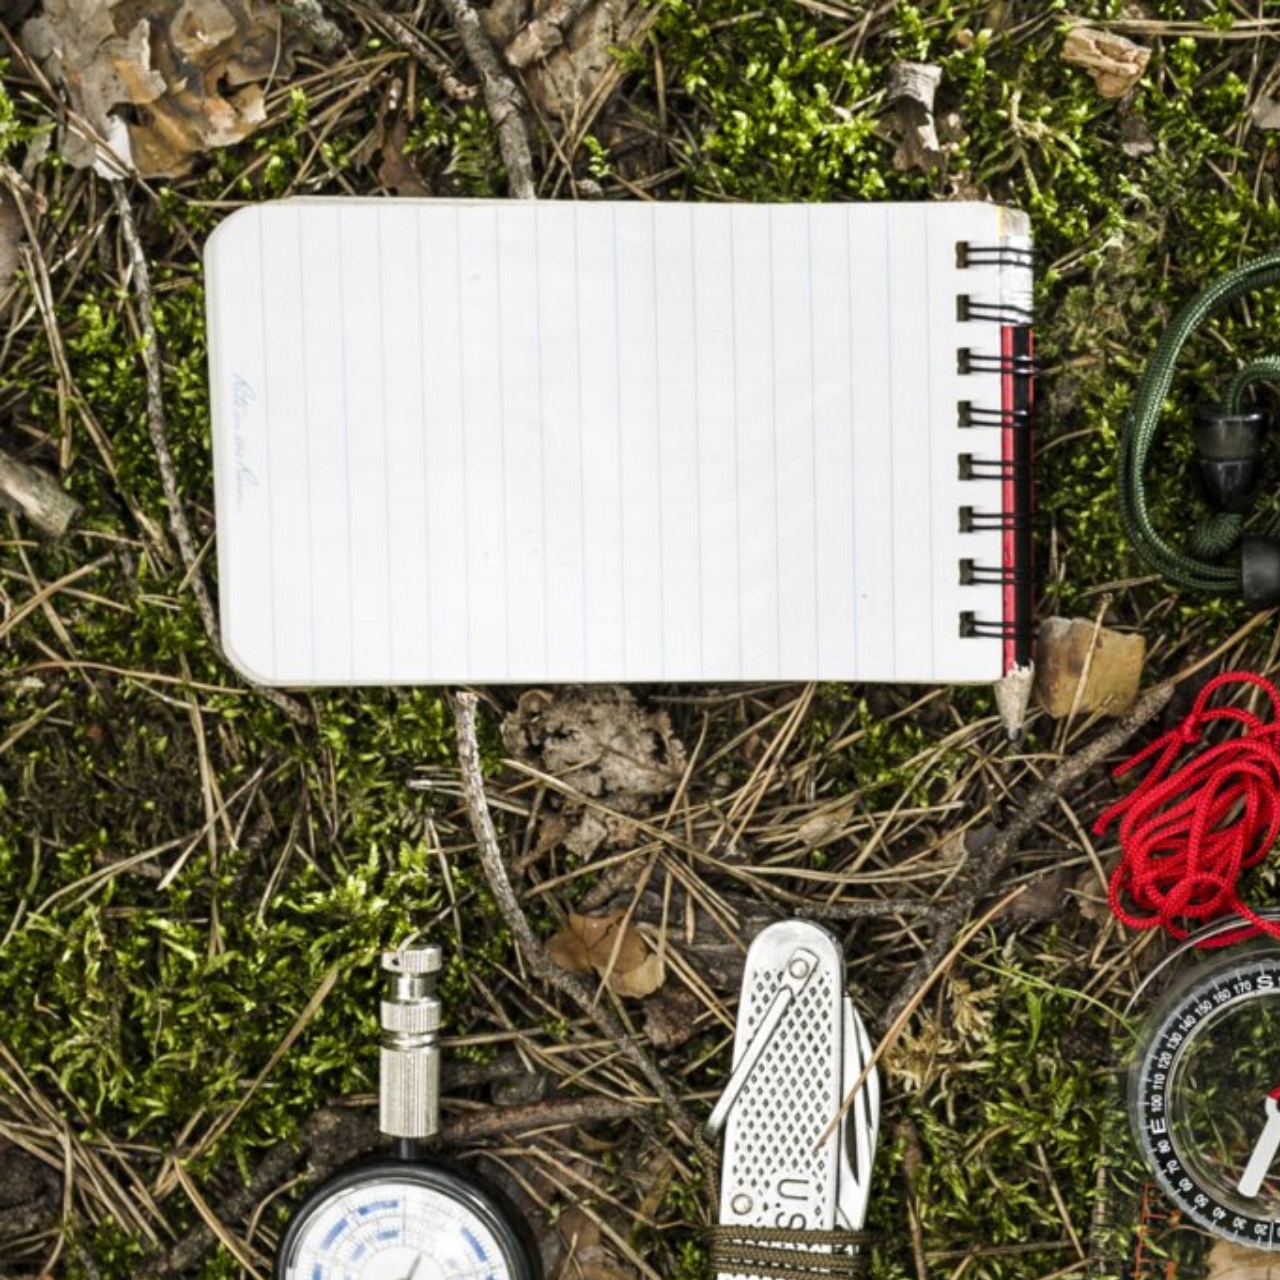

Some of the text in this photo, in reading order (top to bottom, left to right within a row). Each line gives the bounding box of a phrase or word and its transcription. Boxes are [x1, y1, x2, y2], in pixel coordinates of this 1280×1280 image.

[1234, 980, 1251, 995] 170
[1257, 975, 1274, 991] S
[1195, 1000, 1212, 1016] 150
[1179, 1015, 1196, 1031] 140
[1167, 1032, 1182, 1049] 130
[1158, 1052, 1172, 1069] 120
[1153, 1073, 1165, 1089] 110
[1151, 1095, 1162, 1112] 100
[1150, 1118, 1167, 1134] E
[1167, 1160, 1179, 1173] 70
[1195, 1194, 1208, 1207] 50
[1213, 1207, 1226, 1219] 40
[1233, 1217, 1247, 1229] 30
[1254, 1224, 1268, 1235] 20
